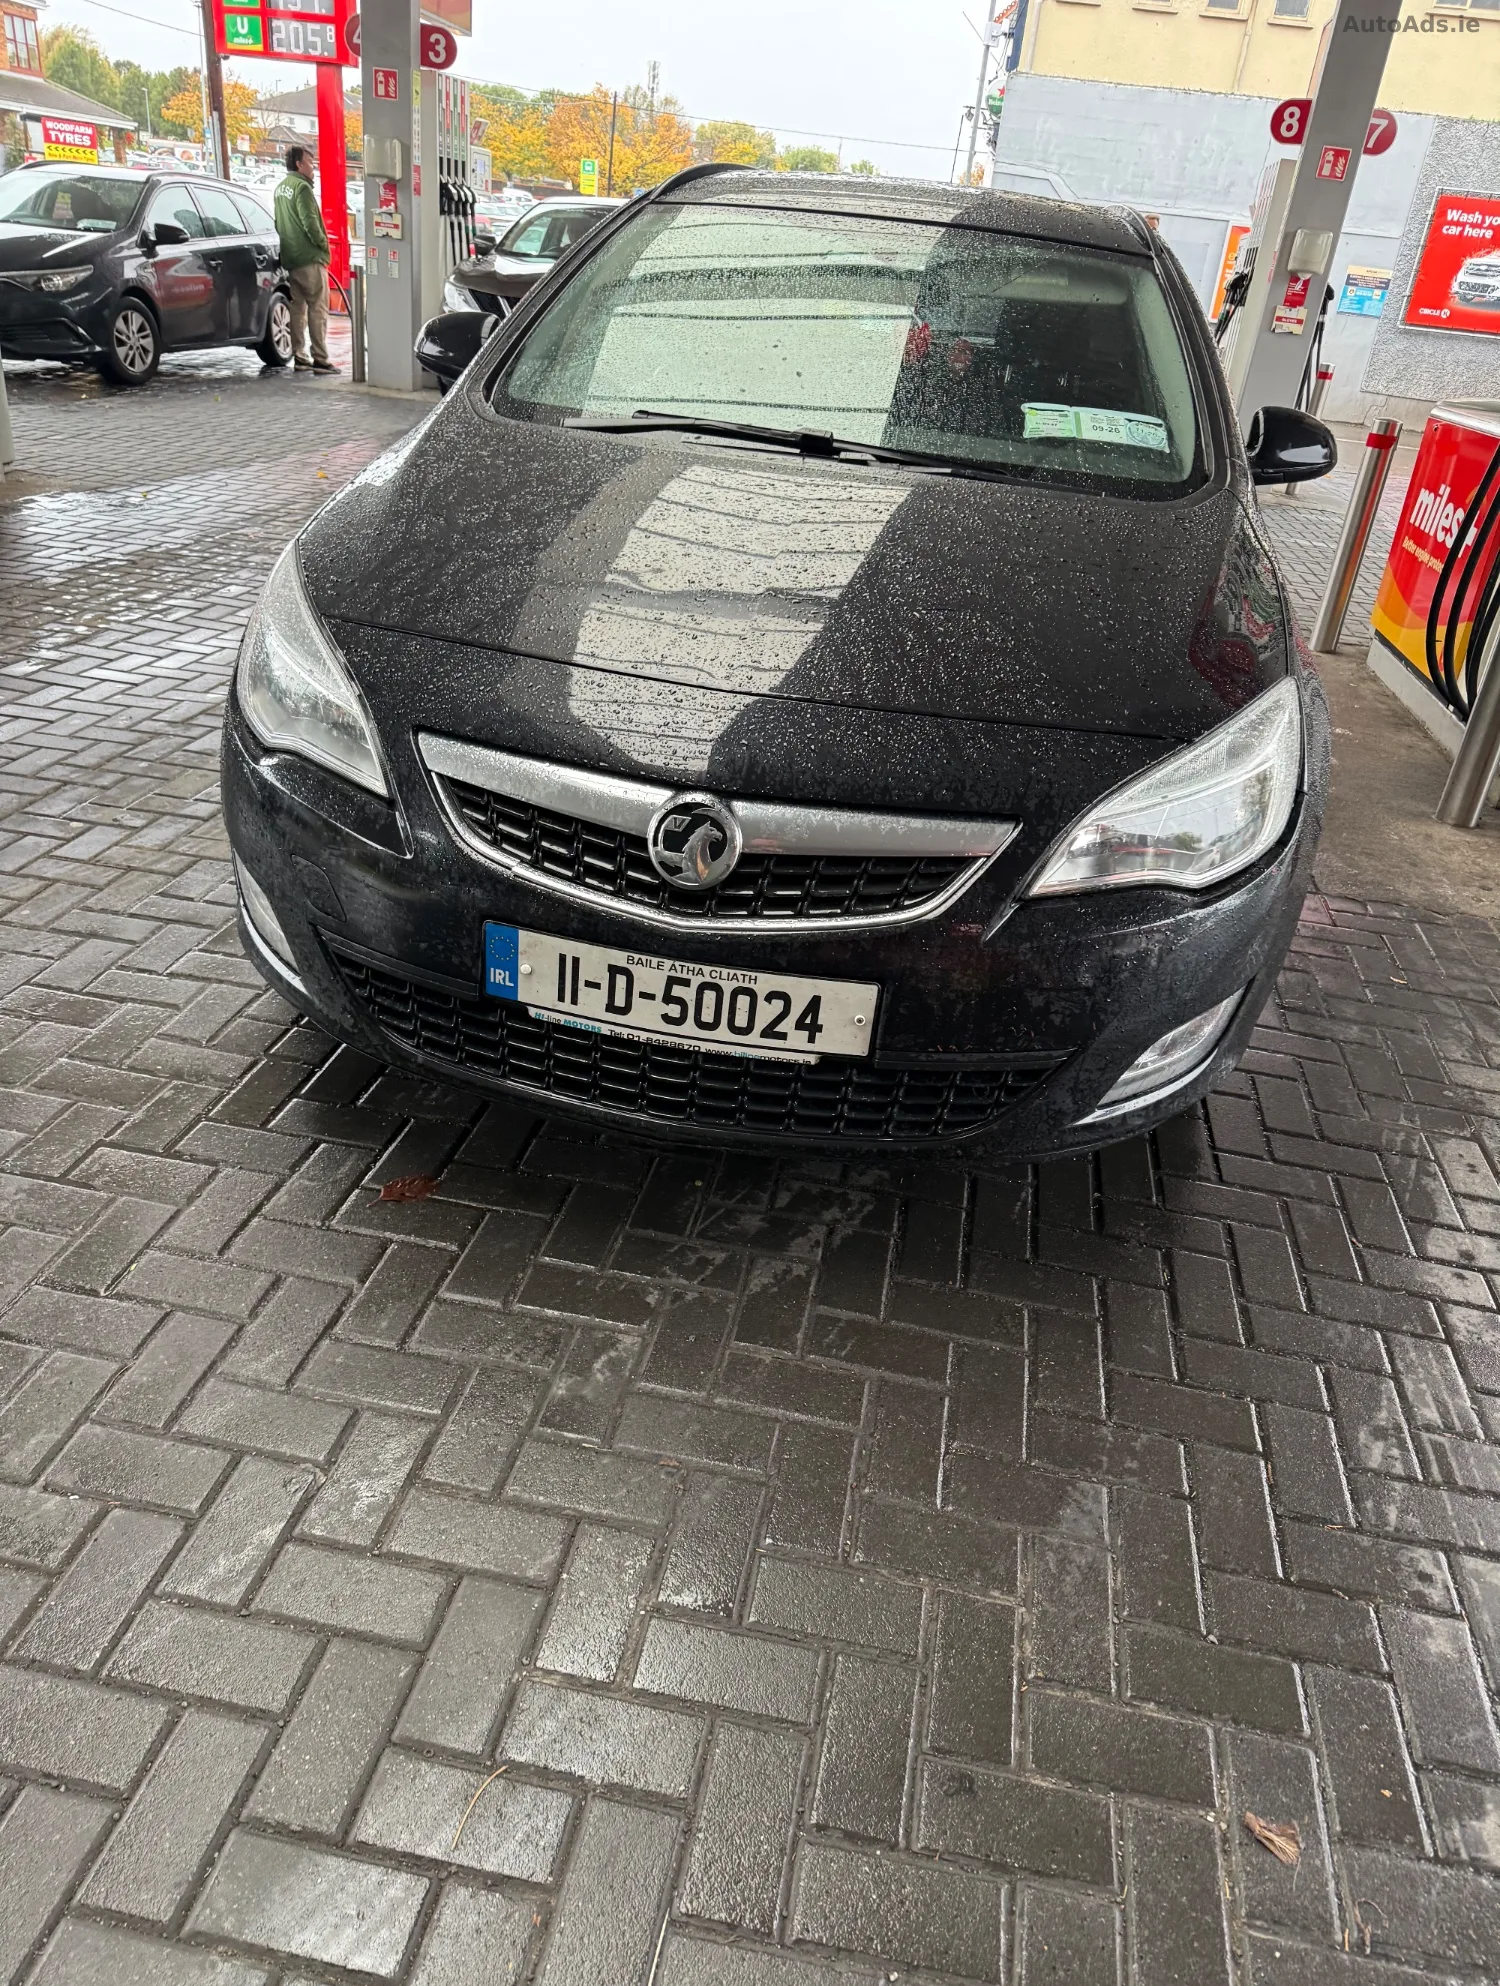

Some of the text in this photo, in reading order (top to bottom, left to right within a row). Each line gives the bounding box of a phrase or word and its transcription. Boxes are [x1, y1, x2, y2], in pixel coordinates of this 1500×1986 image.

[236, 17, 248, 34] U
[429, 33, 446, 64] 3
[45, 120, 93, 135] WOODFARM
[1280, 106, 1301, 138] 8
[49, 130, 91, 146] TYRES
[1367, 117, 1389, 149] 7
[1446, 209, 1482, 224] Wash
[1442, 225, 1494, 239] car here
[1418, 307, 1440, 316] CIRCLE
[489, 967, 515, 987] IRL
[626, 955, 665, 971] BAILE
[709, 969, 758, 985] CLIATH
[557, 953, 824, 1044] 11-D-50024
[563, 1018, 603, 1034] MOTORS
[608, 1028, 625, 1039] Tel:
